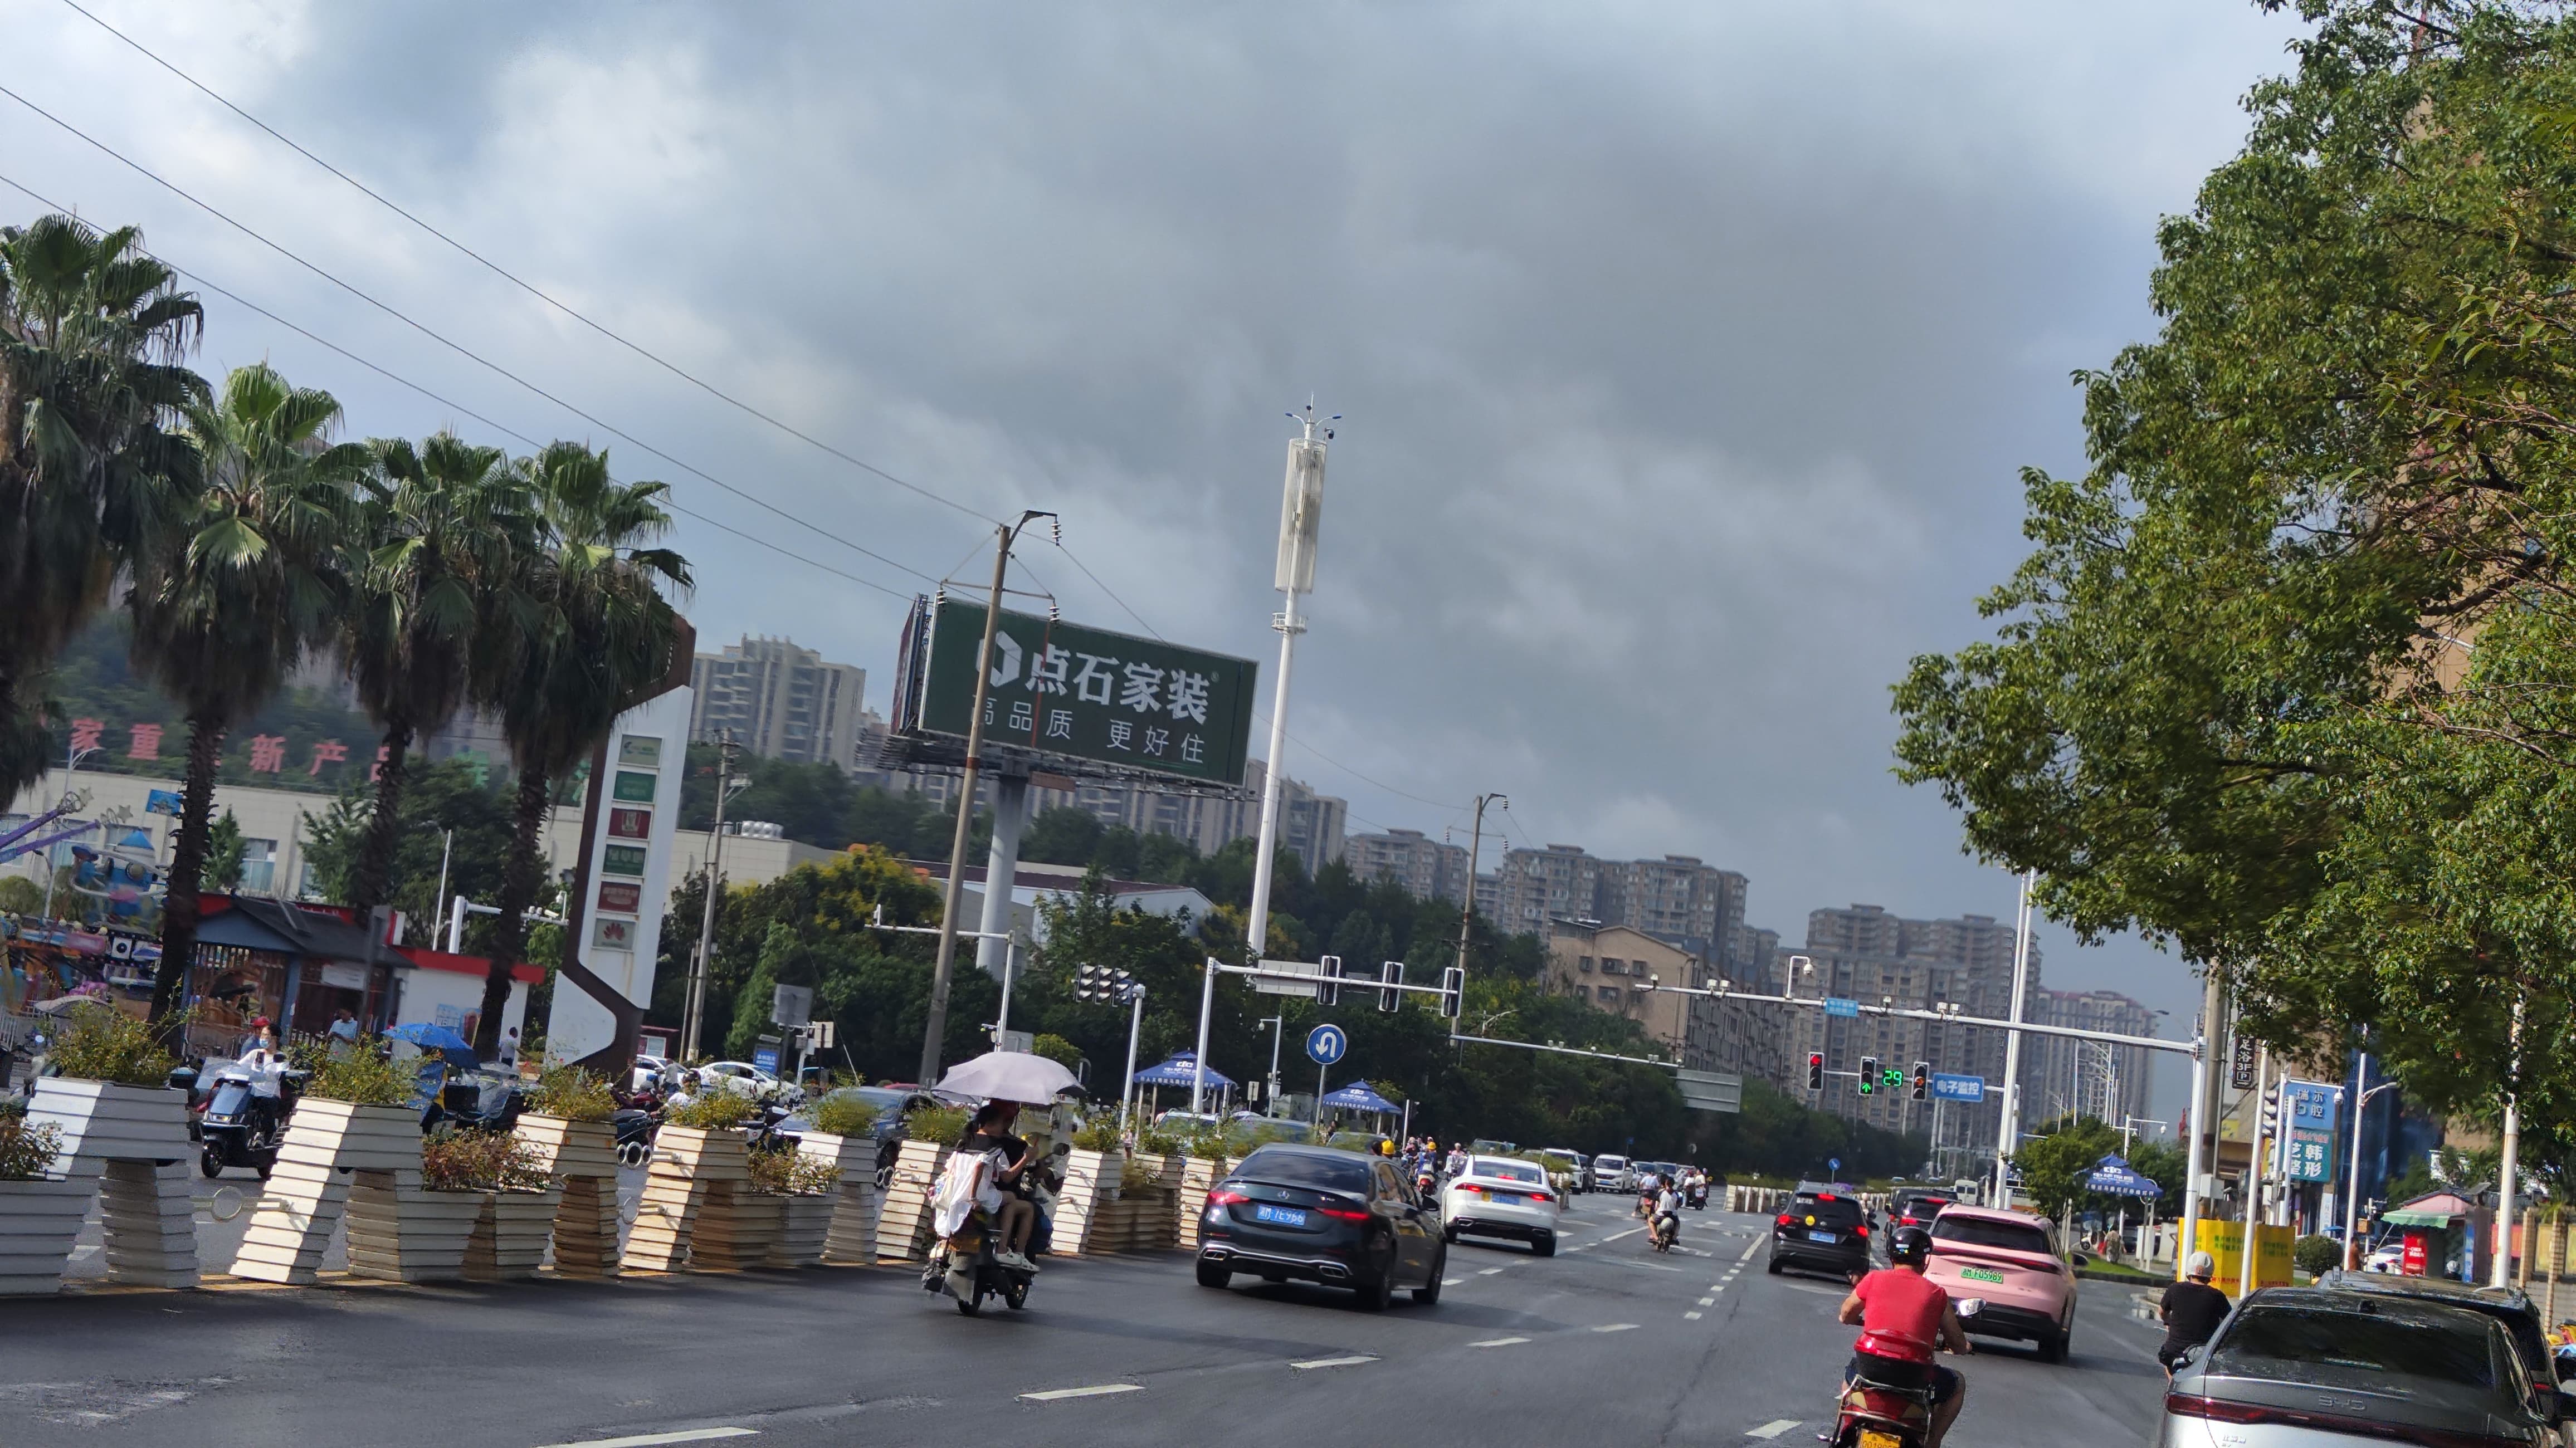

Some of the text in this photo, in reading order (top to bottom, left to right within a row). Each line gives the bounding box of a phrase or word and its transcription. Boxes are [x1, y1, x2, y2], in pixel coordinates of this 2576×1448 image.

[1026, 642, 1211, 725] 点石家装
[1106, 718, 1205, 764] 更好住
[2237, 1063, 2252, 1071] 3F
[1884, 1070, 1902, 1087] 29
[1936, 1080, 1979, 1095] 电子监控
[2319, 1395, 2365, 1411] BYD
